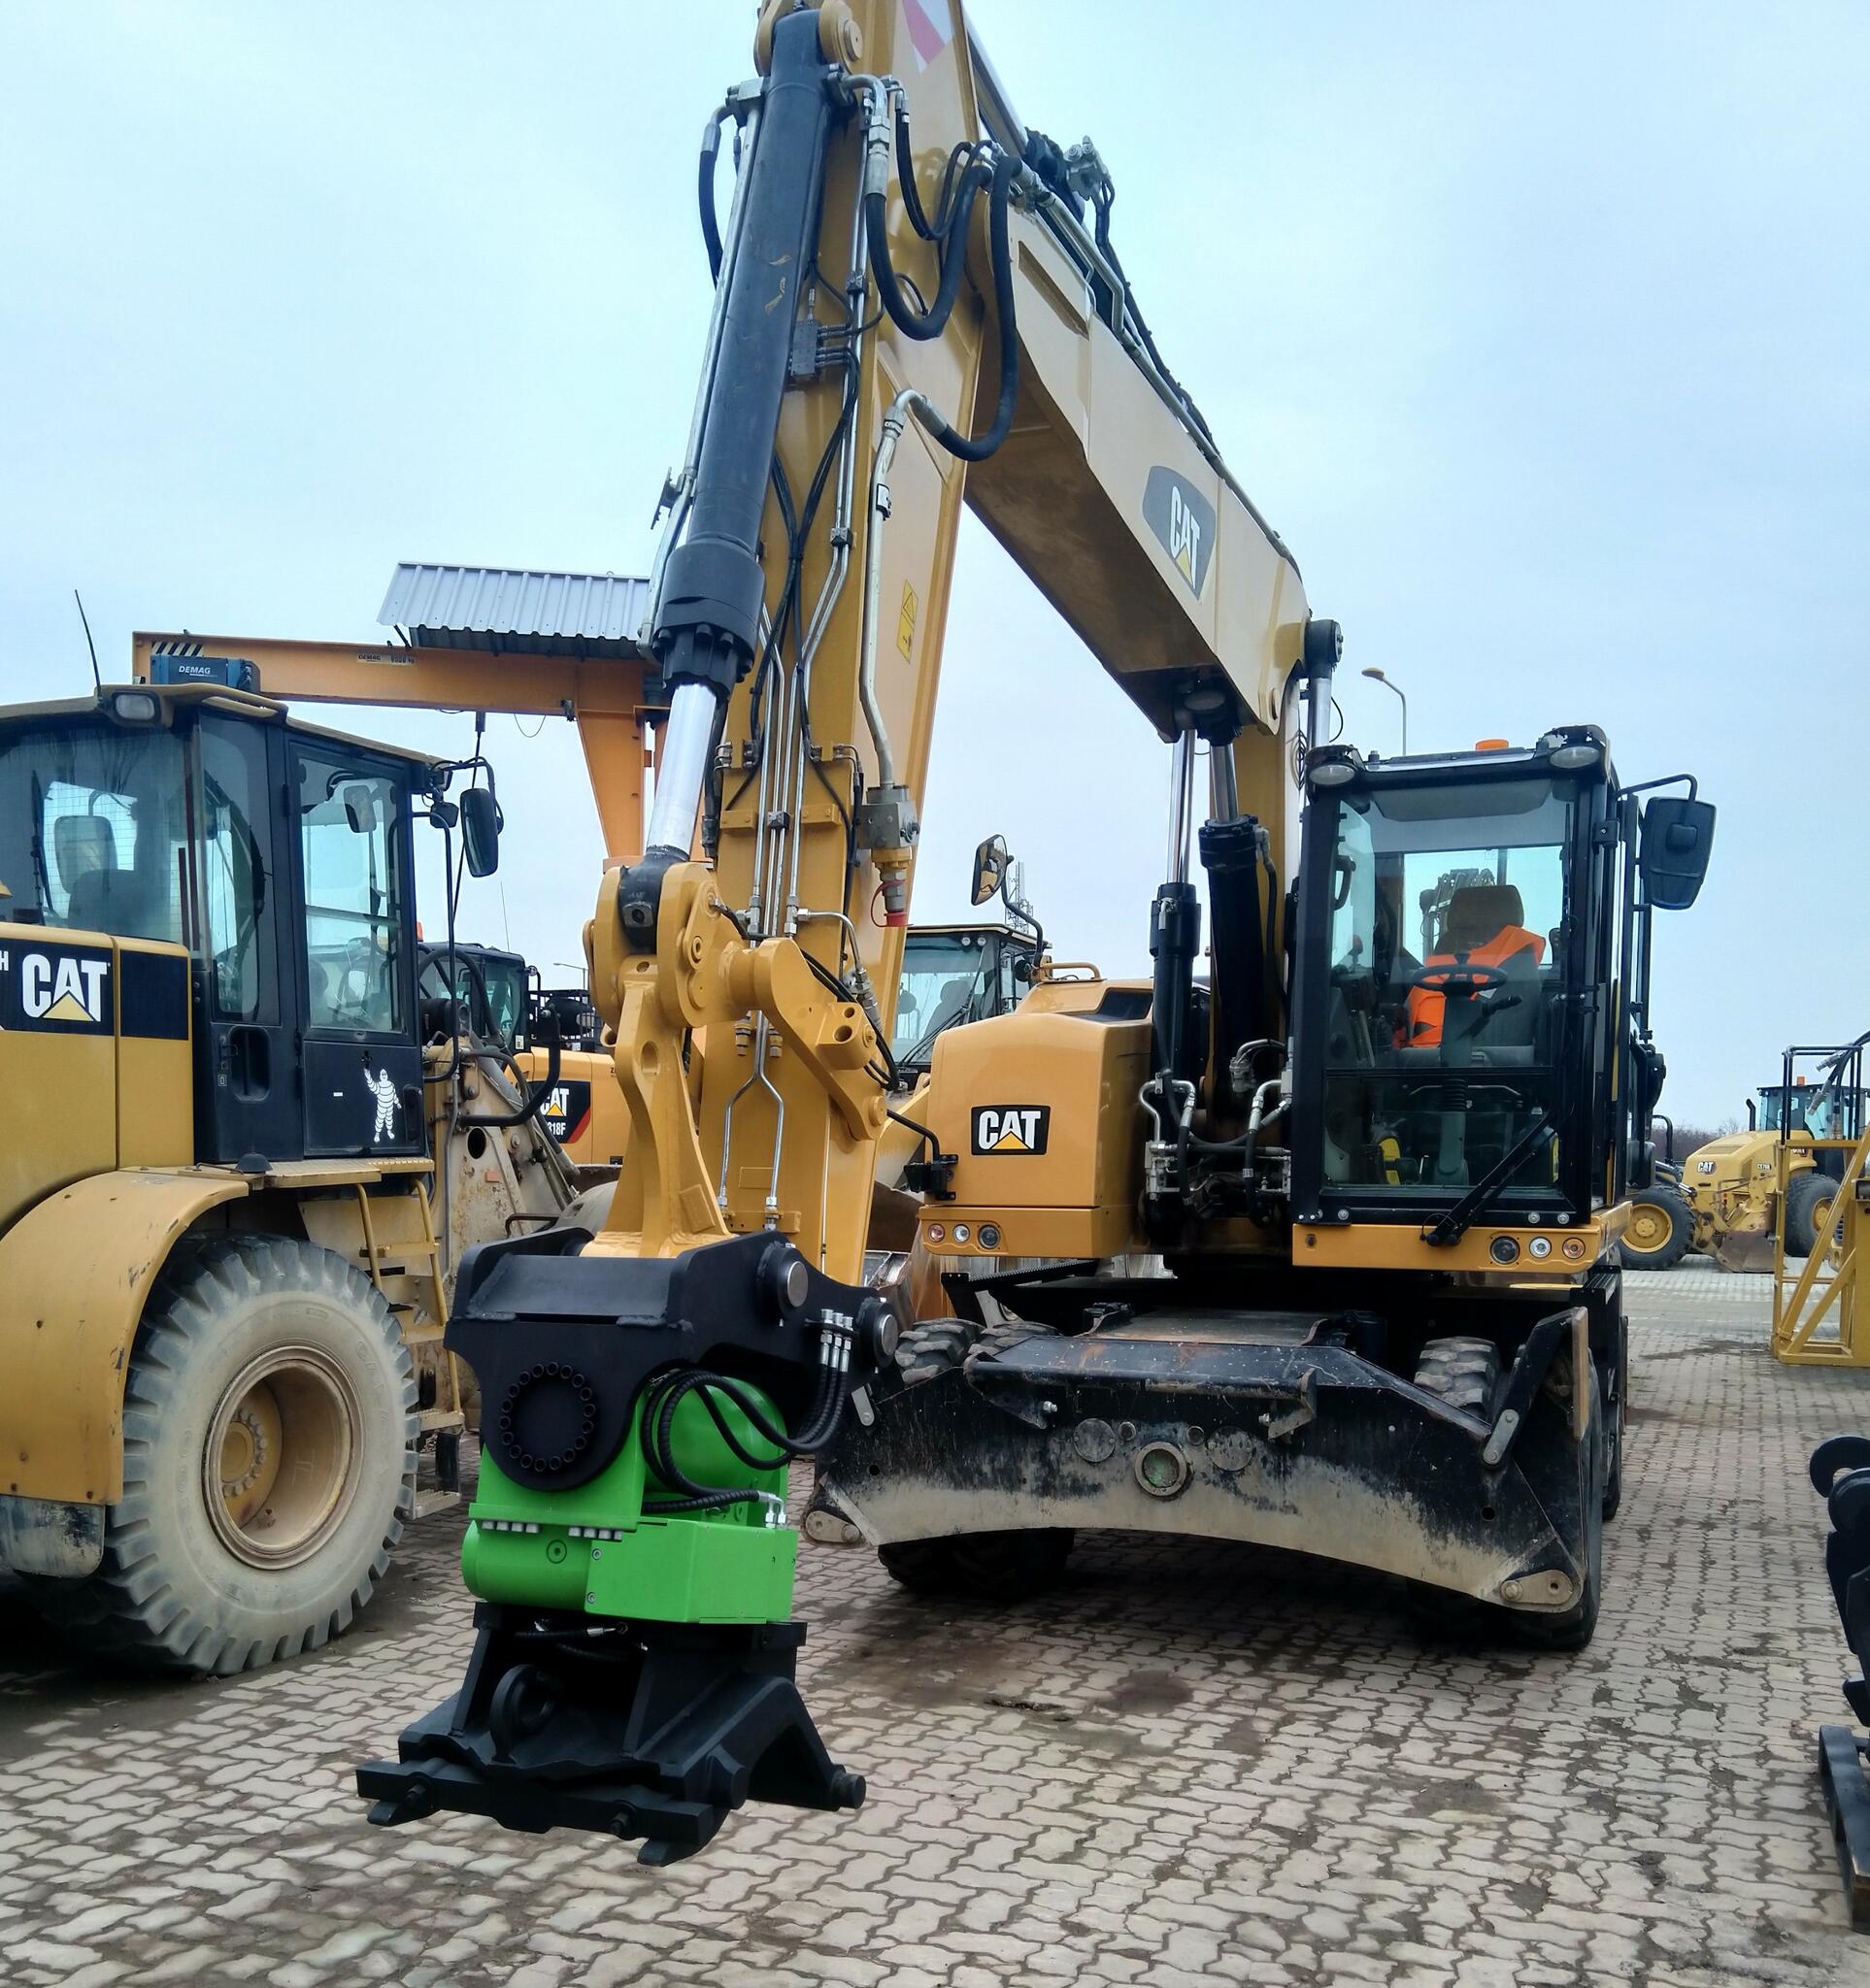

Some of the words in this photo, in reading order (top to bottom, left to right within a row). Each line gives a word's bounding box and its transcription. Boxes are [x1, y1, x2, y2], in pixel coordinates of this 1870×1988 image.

[1170, 485, 1200, 589] CAT
[178, 665, 211, 675] DEMAG
[22, 953, 108, 1022] CAT
[978, 1110, 1041, 1150] CAT
[1697, 1161, 1715, 1173] CAT
